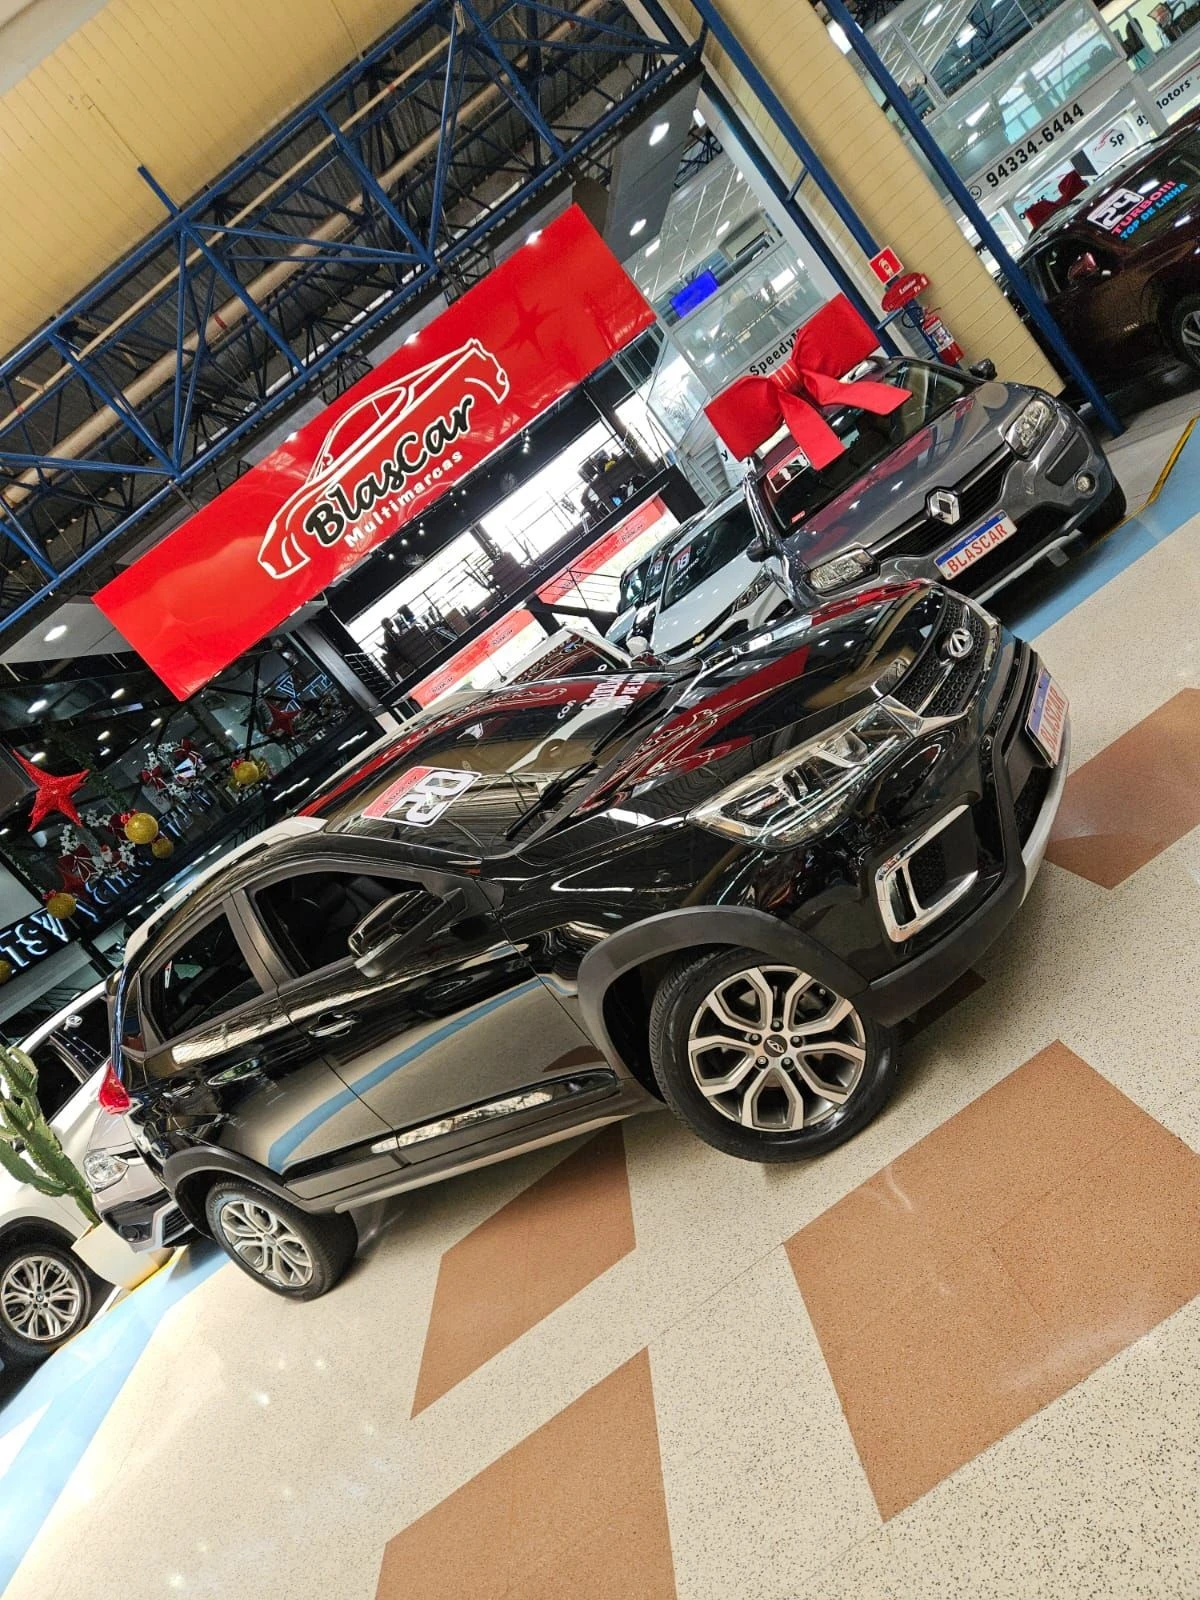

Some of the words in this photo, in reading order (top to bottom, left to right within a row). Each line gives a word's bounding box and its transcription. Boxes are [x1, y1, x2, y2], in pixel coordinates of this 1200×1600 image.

[986, 103, 1085, 188] 94334-6444
[1095, 193, 1140, 228] 24
[1119, 222, 1140, 240] TOP
[1139, 207, 1156, 223] DE
[1155, 182, 1189, 208] LINHA
[303, 396, 473, 546] BlasCar
[344, 450, 463, 548] Multimarcas
[946, 523, 1008, 573] BLASCAR
[1040, 685, 1067, 753] BLASCAR
[387, 771, 475, 822] 20
